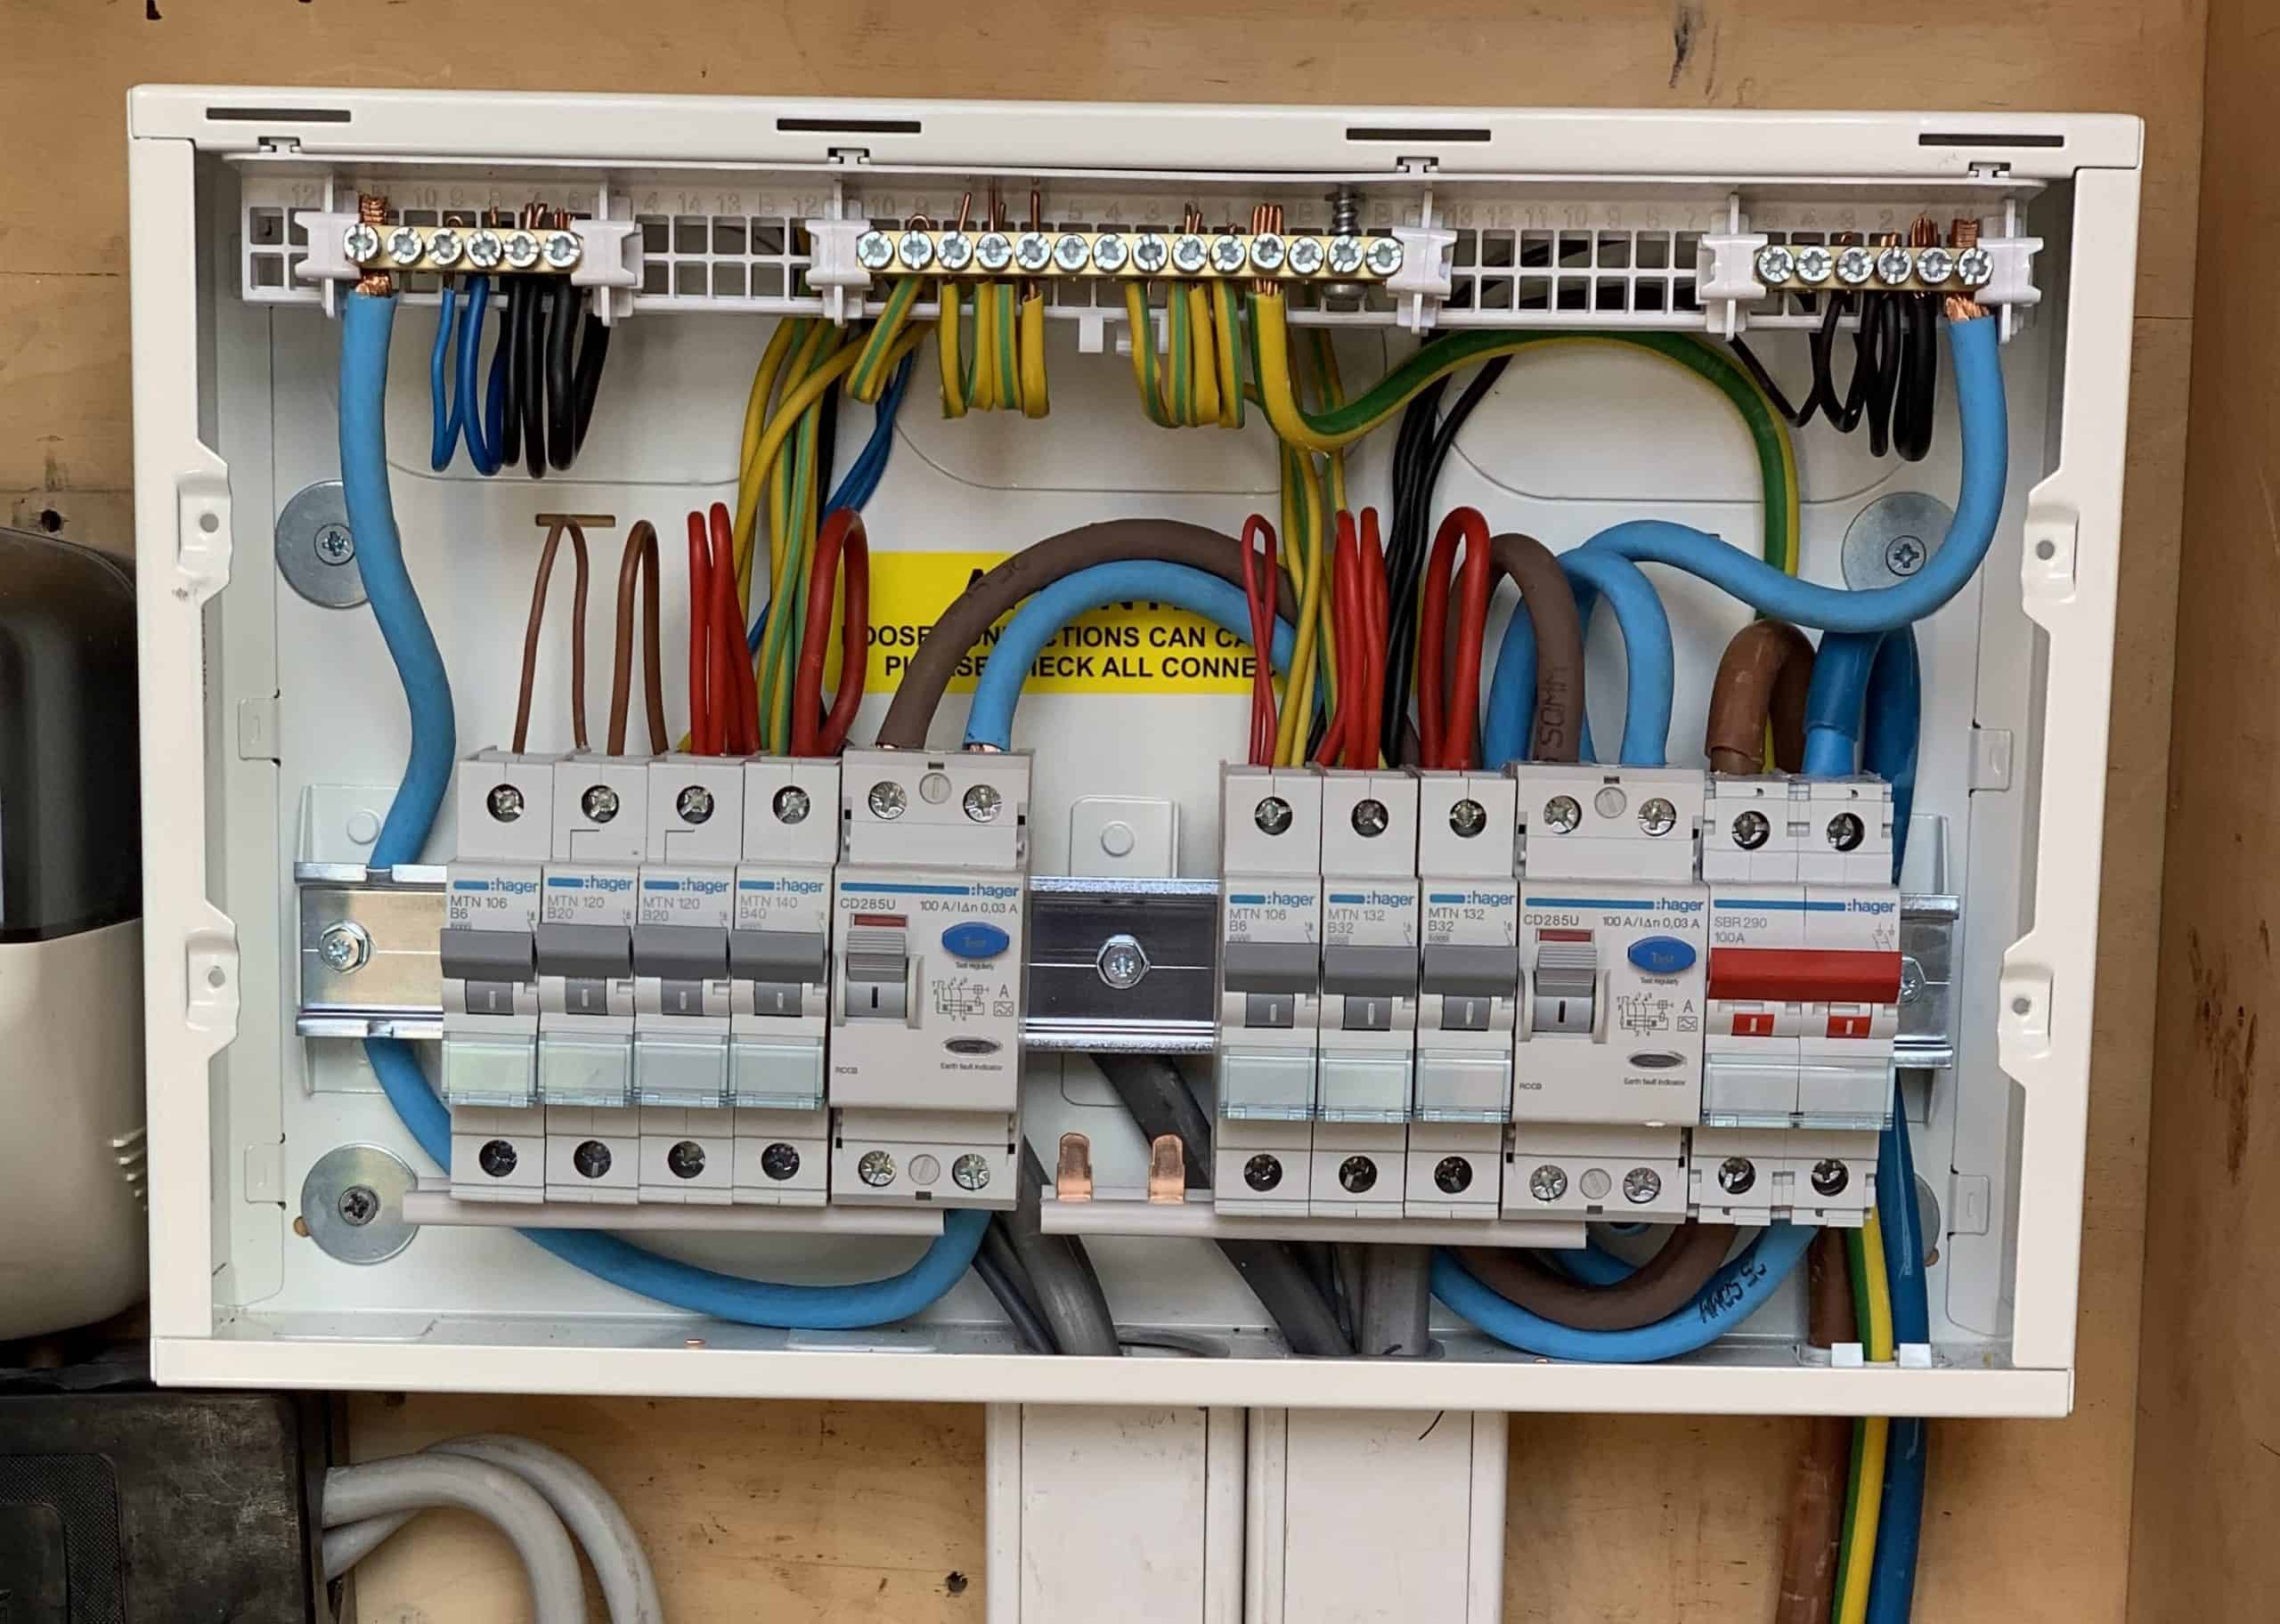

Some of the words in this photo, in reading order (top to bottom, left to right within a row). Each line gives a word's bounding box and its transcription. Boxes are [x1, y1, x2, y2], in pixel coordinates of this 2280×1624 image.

[1149, 626, 1206, 648] CAN
[1102, 656, 1154, 677] ALL
[840, 898, 896, 910] CD285U
[1524, 914, 1579, 926] CD285U
[1714, 916, 1741, 928] SBR
[1744, 917, 1768, 929] 290
